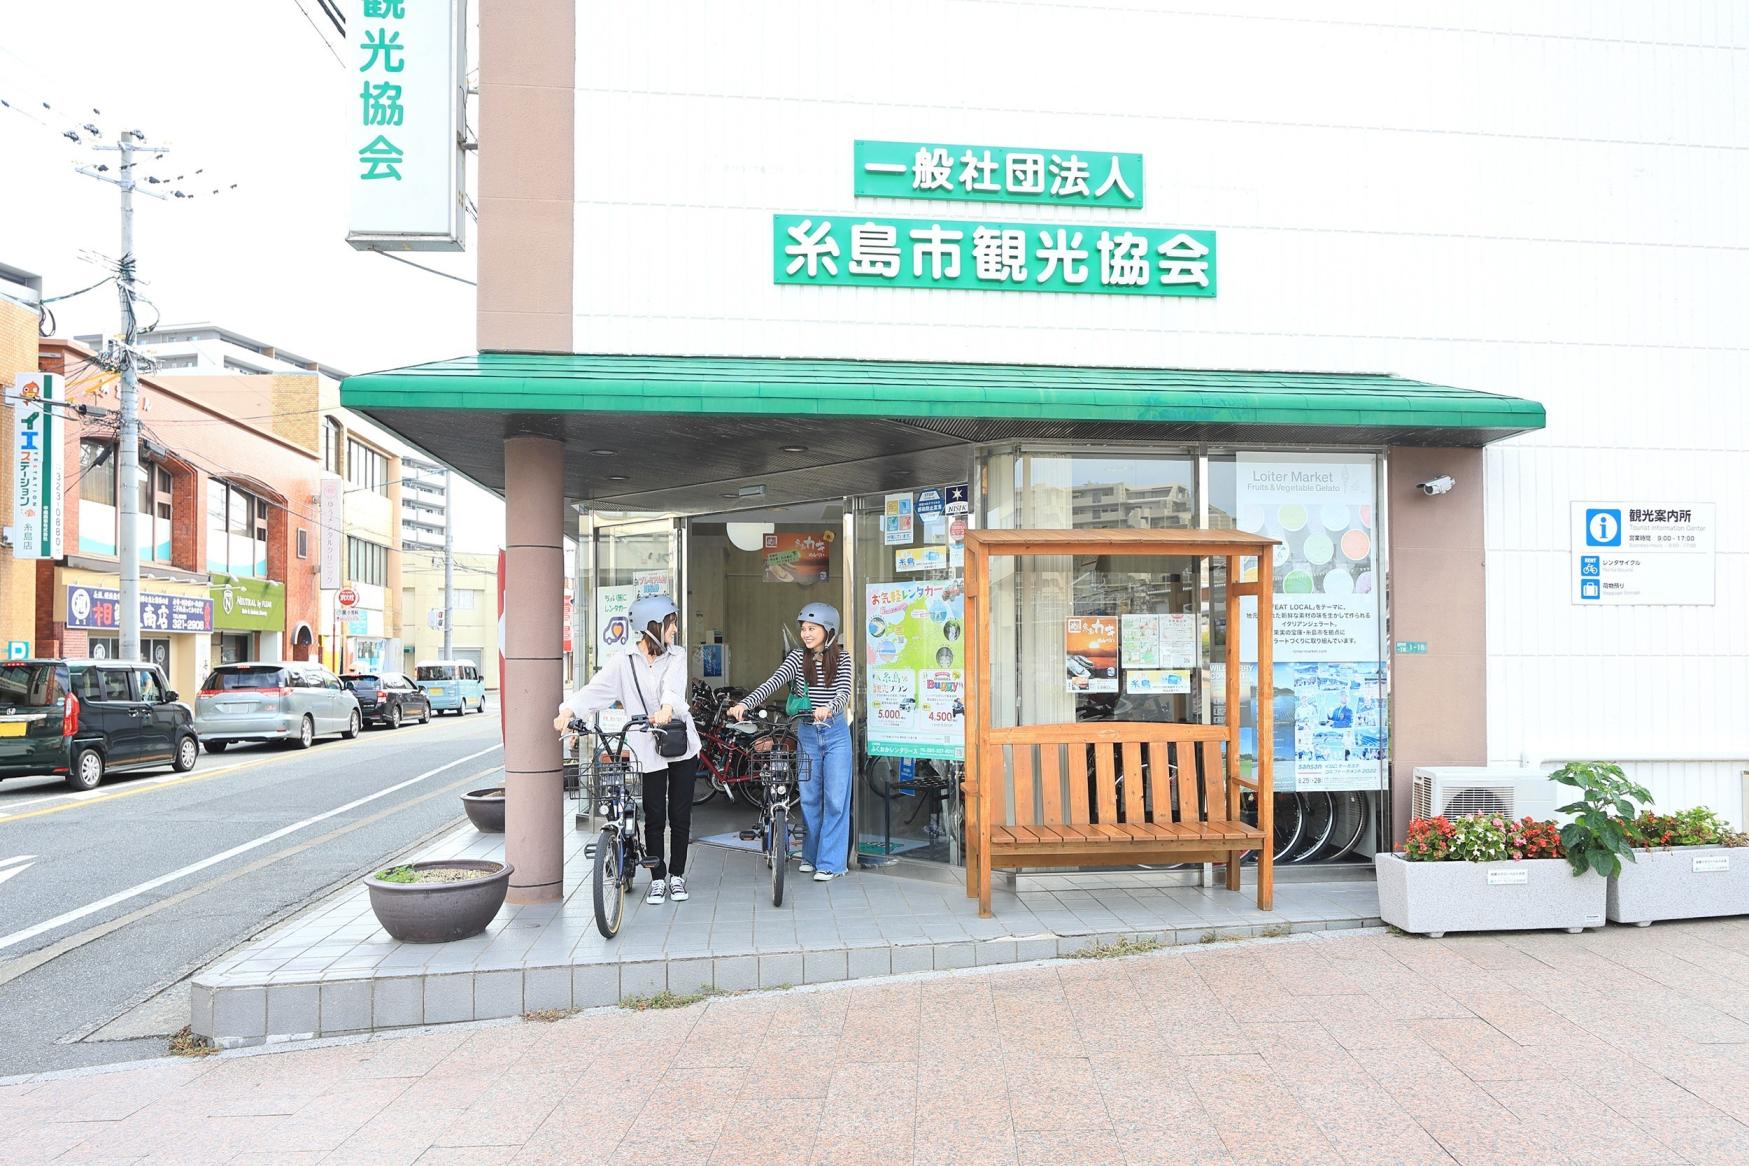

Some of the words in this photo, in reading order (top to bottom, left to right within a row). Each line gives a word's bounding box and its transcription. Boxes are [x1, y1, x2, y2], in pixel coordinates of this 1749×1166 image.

[864, 147, 1135, 199] 一般社団法人
[785, 219, 1210, 287] 糸島市観光協会
[20, 411, 39, 507] イエステーション
[1253, 471, 1288, 482] Loiter
[1291, 471, 1333, 483] Market
[1247, 483, 1270, 491] Fruits
[1276, 483, 1314, 493] Vegetable
[1315, 483, 1341, 492] Gelato
[1629, 509, 1692, 523] 観光案内所
[872, 585, 943, 606] お気軽レンタカー
[926, 679, 958, 693] Buggy
